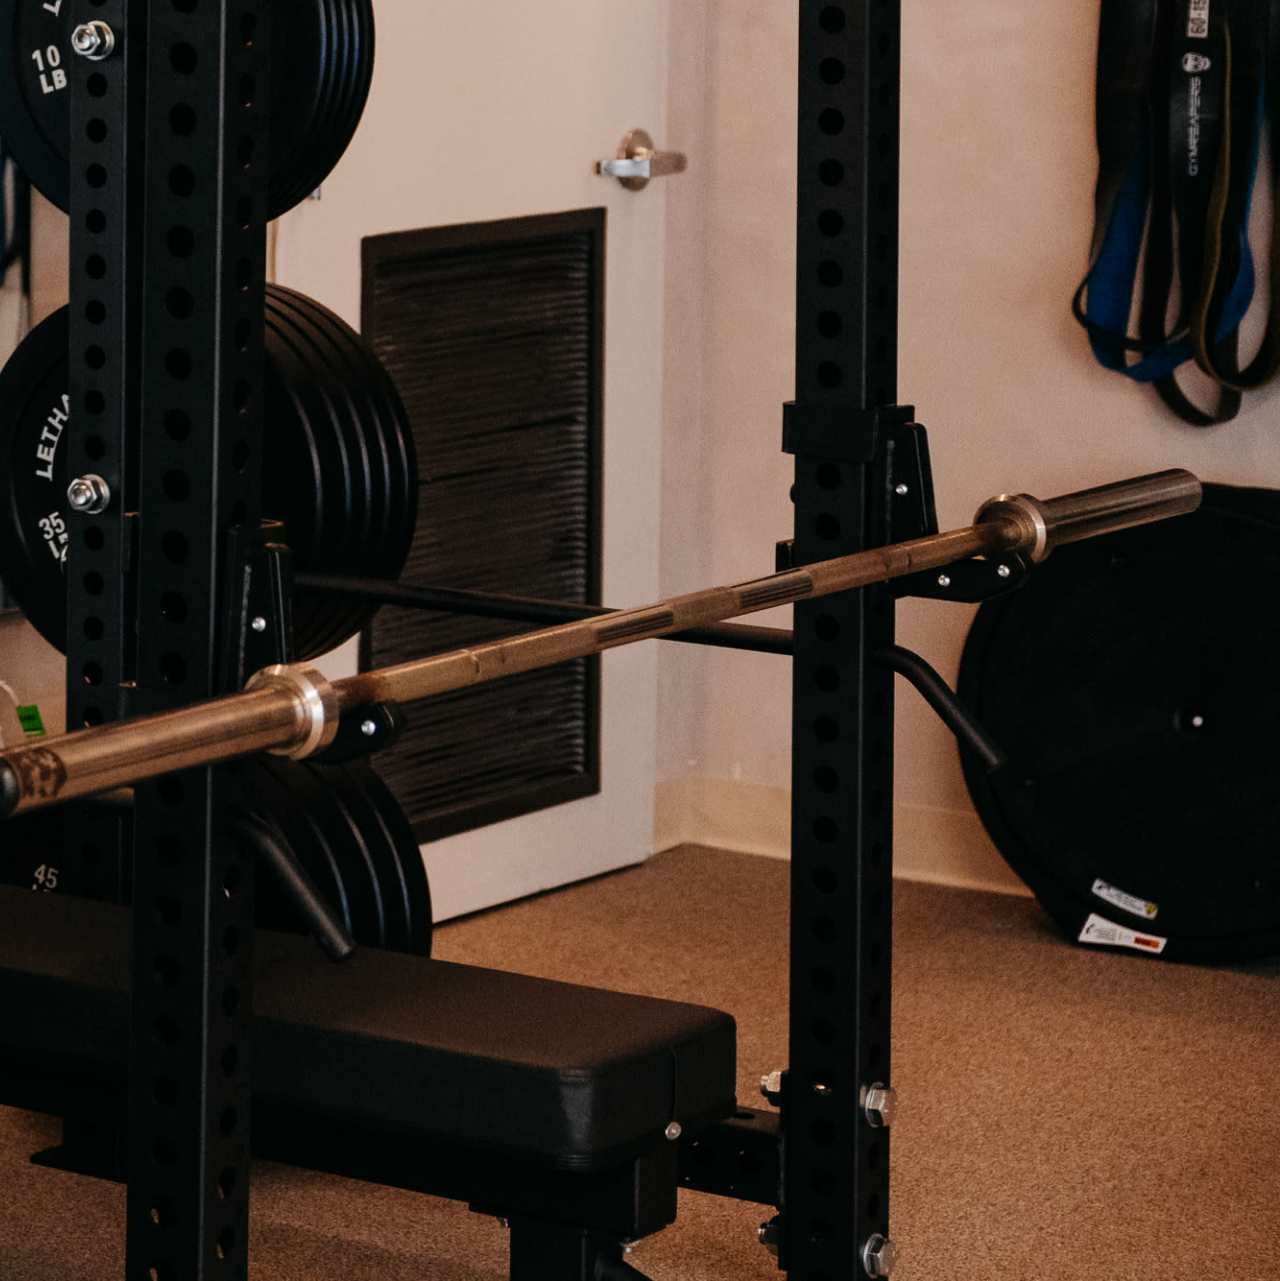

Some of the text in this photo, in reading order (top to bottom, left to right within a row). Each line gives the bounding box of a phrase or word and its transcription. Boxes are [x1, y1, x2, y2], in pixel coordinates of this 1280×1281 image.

[32, 44, 61, 71] 10
[39, 68, 67, 95] LB
[38, 511, 67, 541] 35
[33, 864, 60, 890] 45
